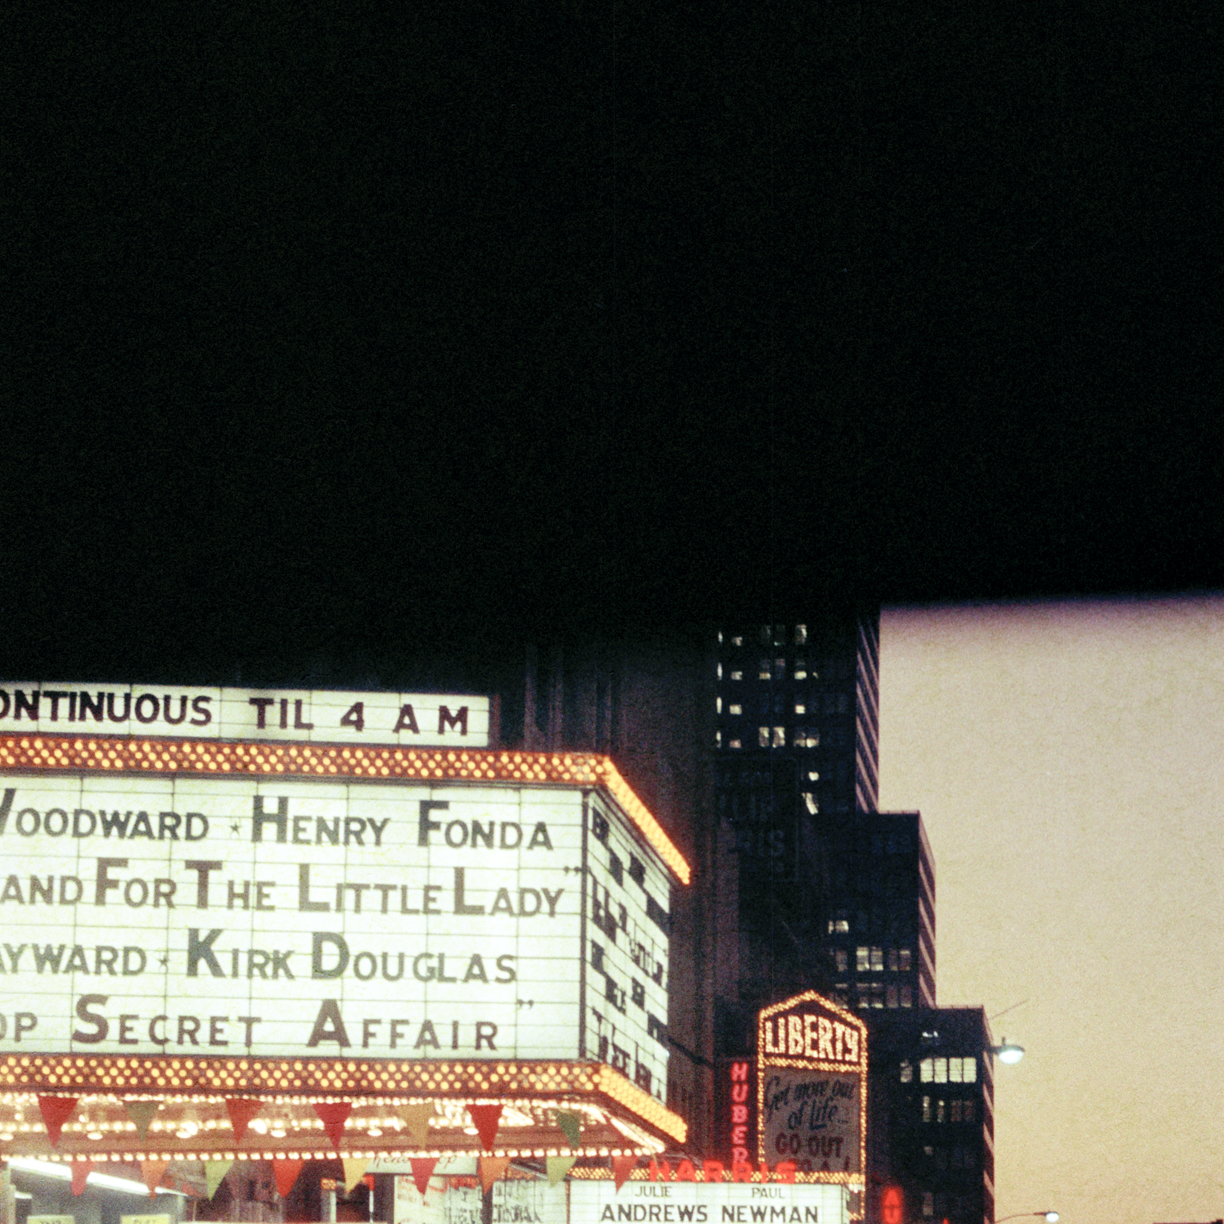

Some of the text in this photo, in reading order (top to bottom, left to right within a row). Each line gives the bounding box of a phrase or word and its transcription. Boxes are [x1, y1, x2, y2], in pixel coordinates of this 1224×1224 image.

[249, 697, 314, 730] TIL
[340, 701, 364, 731] 4
[251, 795, 391, 847] HENRY
[417, 799, 554, 851] FONDA
[94, 857, 177, 909] FOR
[184, 860, 276, 911] THE
[299, 863, 442, 915] LITTLE
[0, 928, 517, 984] YWARD KIRK DOUGLAS
[0, 1012, 38, 1042] P
[71, 994, 262, 1048] SECRET
[764, 1014, 859, 1063] LIBERTY
[774, 1131, 844, 1157] GO OUT
[635, 1185, 785, 1199] JULIE PAUL
[650, 1159, 797, 1184] HARRIS
[601, 1204, 818, 1223] ANDREWS NEWMAN
